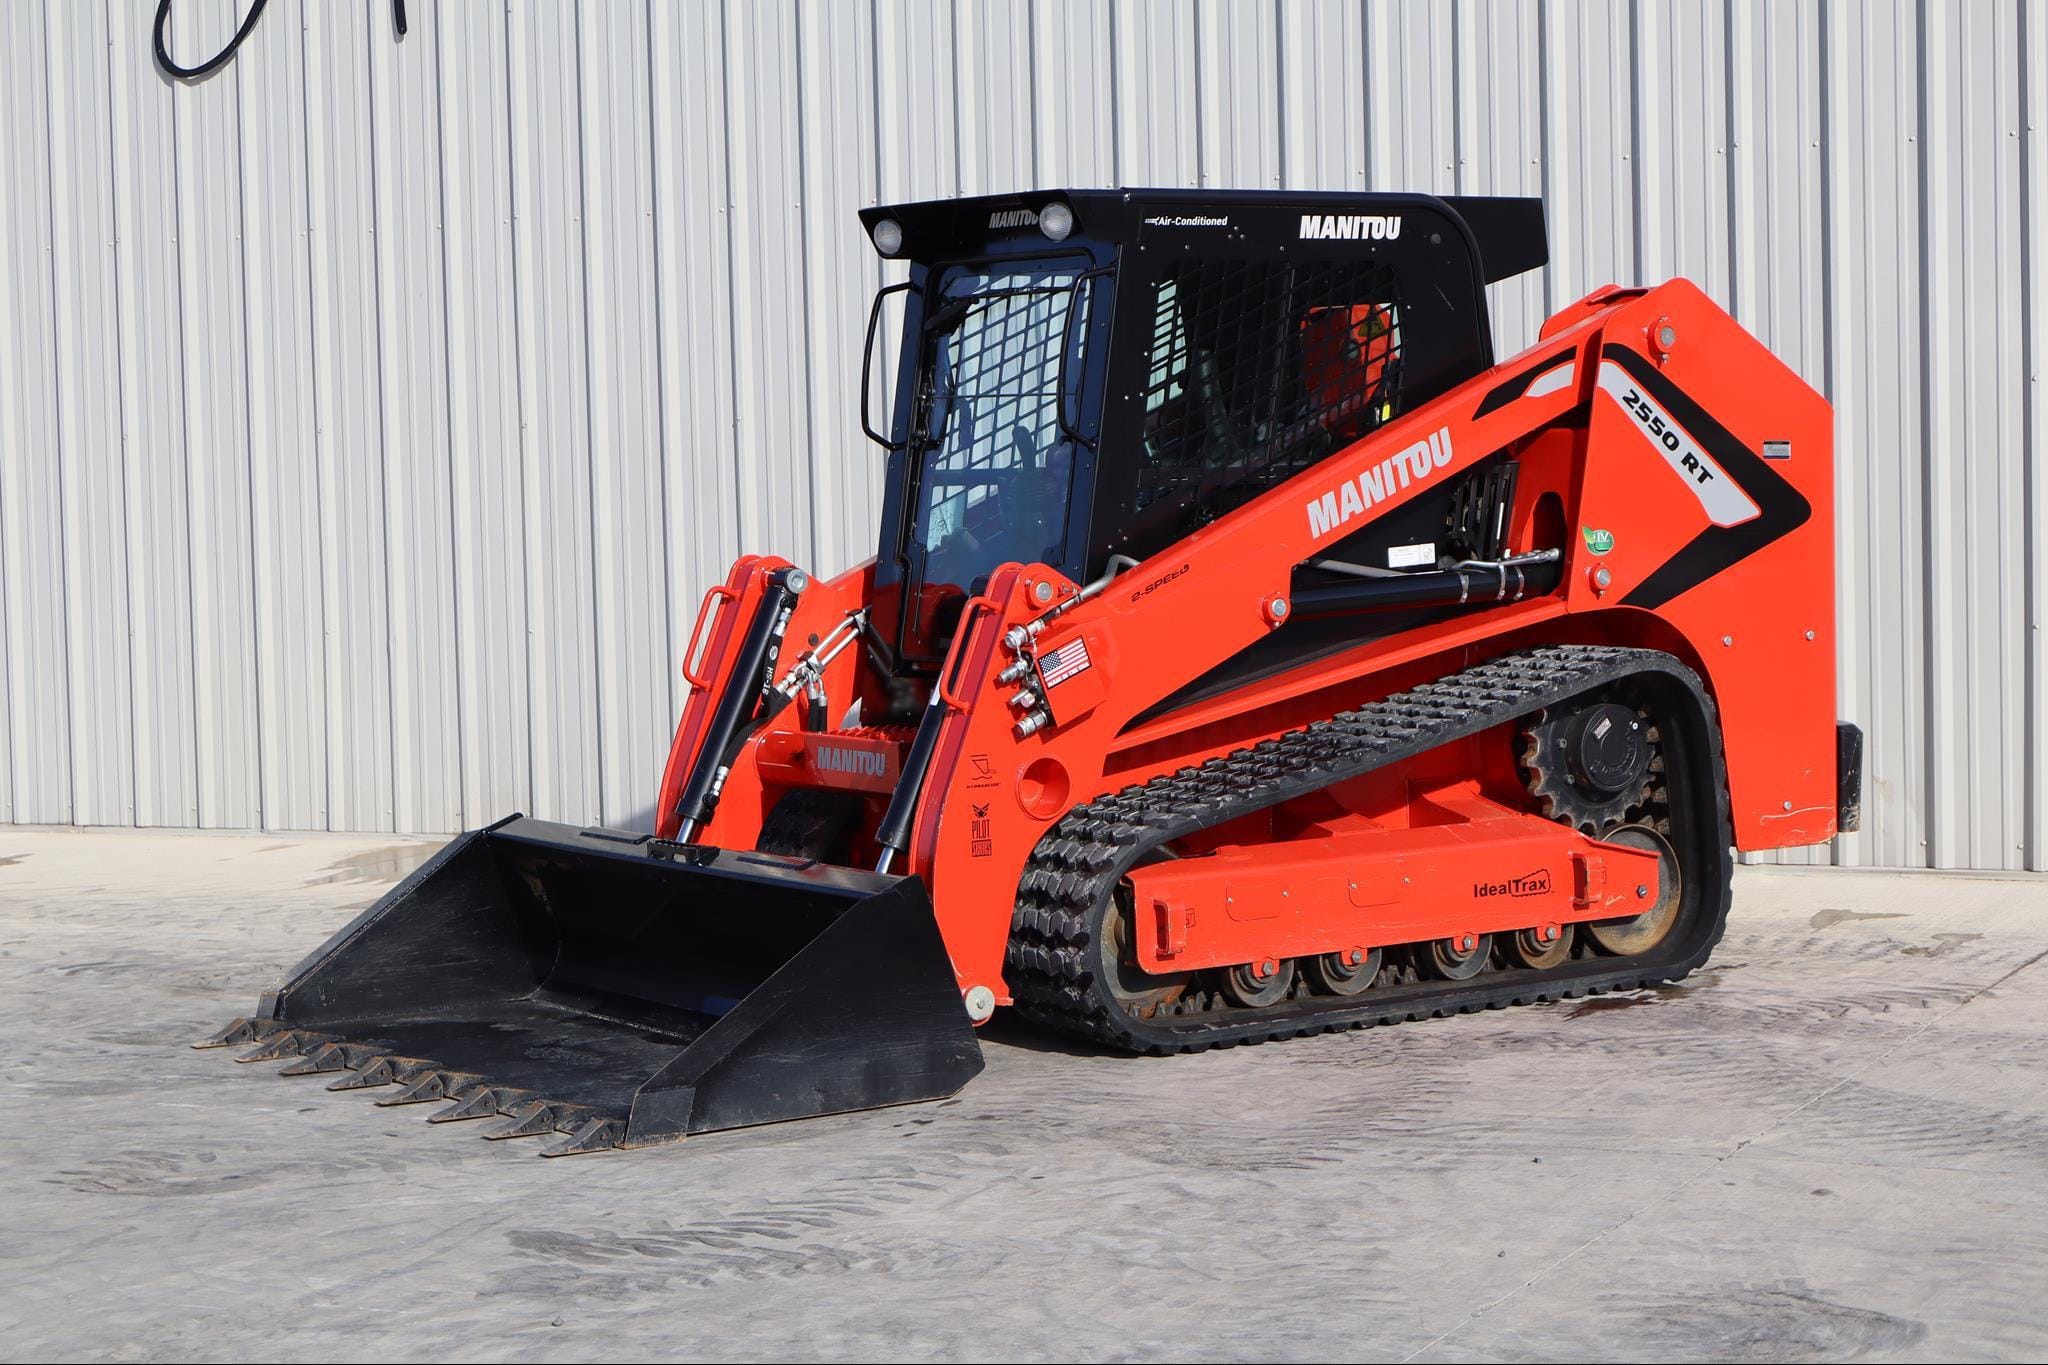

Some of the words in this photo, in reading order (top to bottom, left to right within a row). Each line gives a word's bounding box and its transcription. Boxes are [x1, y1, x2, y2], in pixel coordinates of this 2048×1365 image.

[1158, 215, 1228, 226] Air-Conditioned
[1299, 215, 1402, 240] MANITOU
[1622, 388, 1680, 451] 2550
[1681, 451, 1714, 484] RT
[1306, 425, 1453, 539] MANITOU
[1131, 563, 1190, 602] 2-SPEED
[762, 666, 774, 695] HS-16
[817, 746, 886, 776] MANITOU
[971, 819, 991, 840] PILOT
[1473, 879, 1547, 898] IdealTrax
